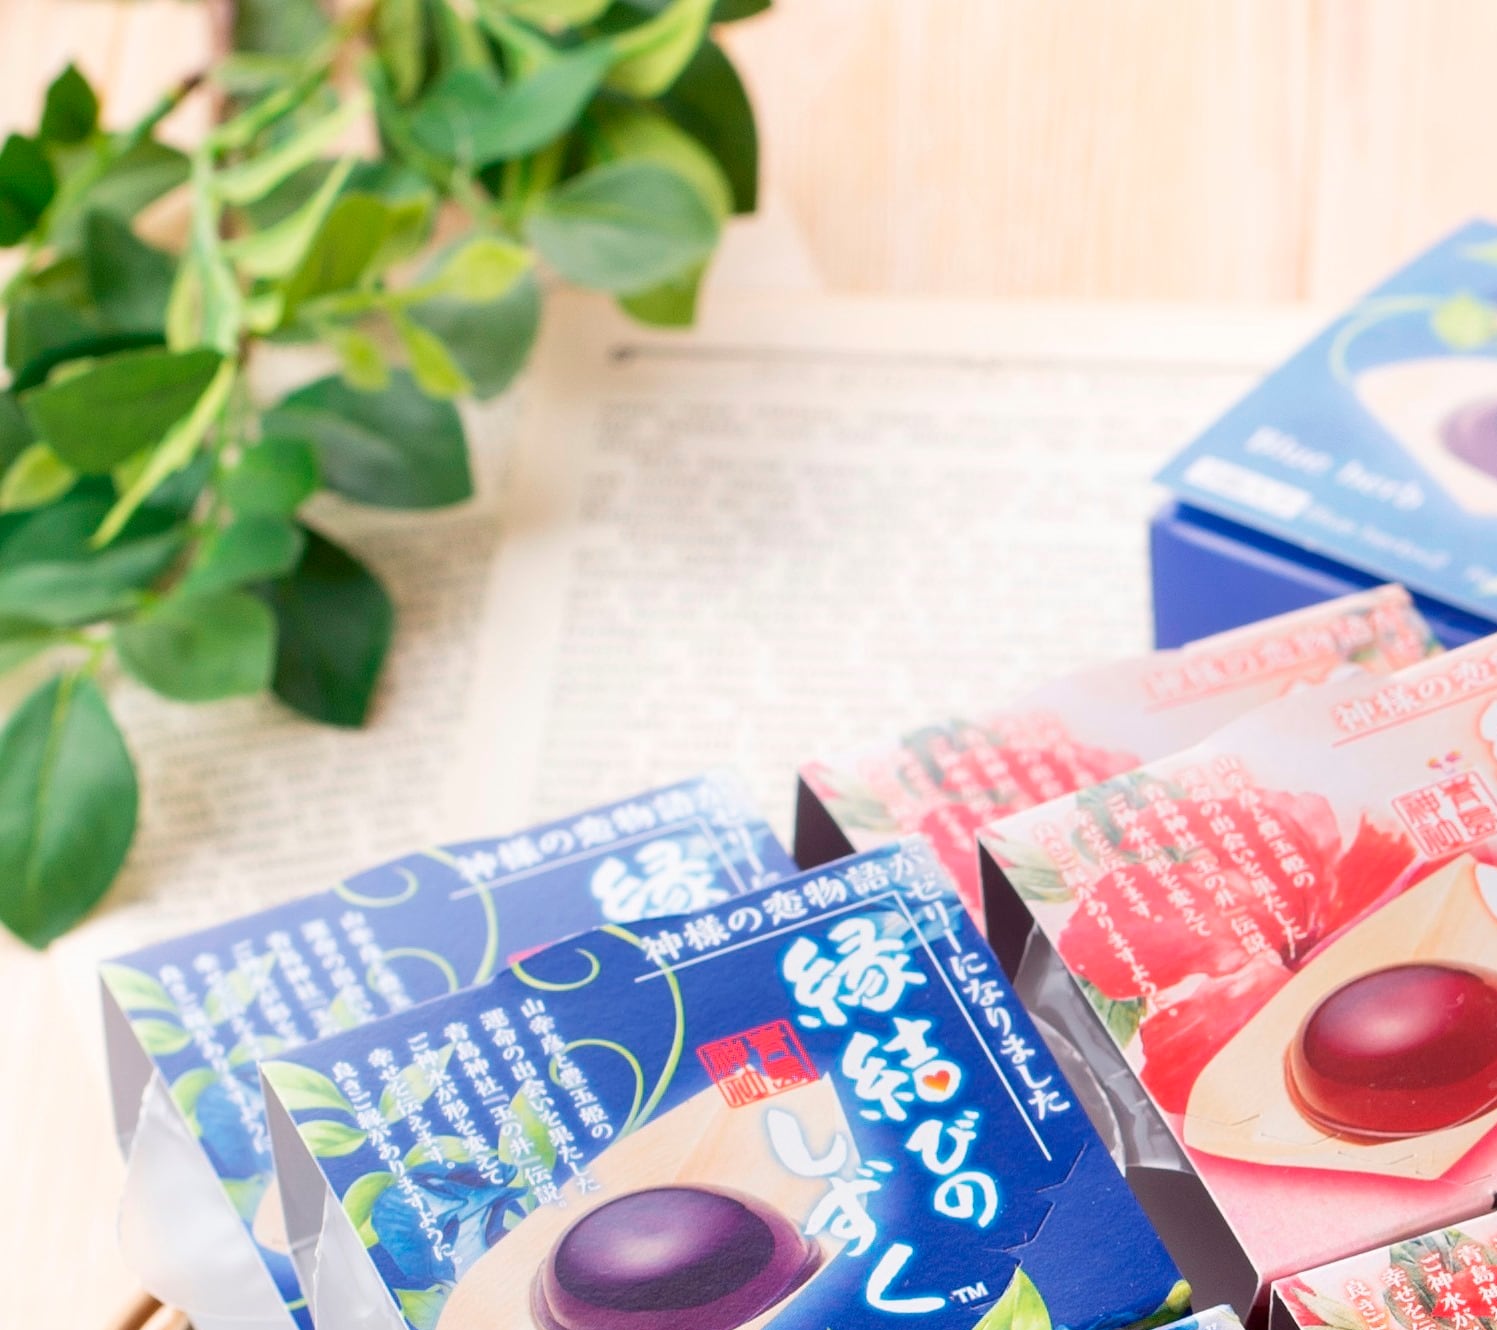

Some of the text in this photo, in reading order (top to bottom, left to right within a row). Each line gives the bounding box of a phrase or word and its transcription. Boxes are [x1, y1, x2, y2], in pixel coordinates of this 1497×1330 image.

[642, 848, 925, 964] 神様の恋物語が
[907, 880, 1071, 1121] ゼリーになりました
[782, 917, 999, 1230] 縁結びの
[766, 1109, 988, 1314] しずく TM
